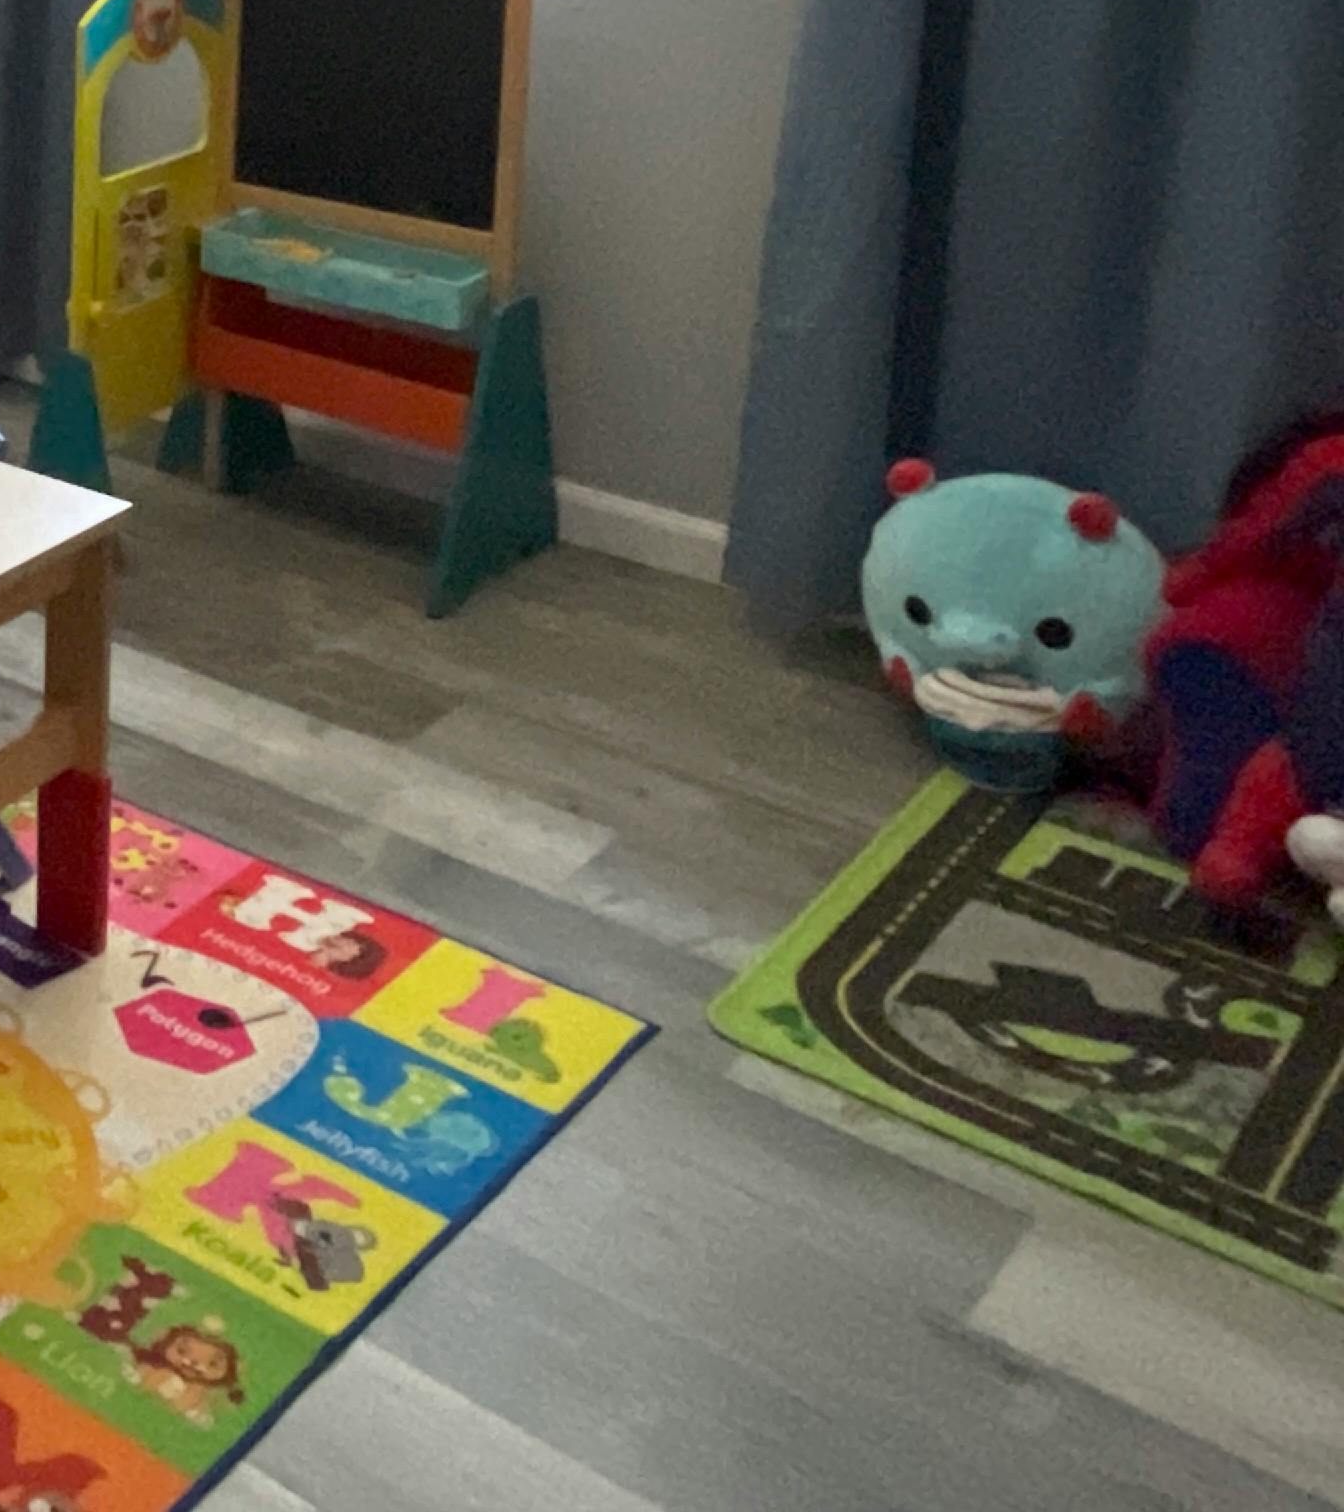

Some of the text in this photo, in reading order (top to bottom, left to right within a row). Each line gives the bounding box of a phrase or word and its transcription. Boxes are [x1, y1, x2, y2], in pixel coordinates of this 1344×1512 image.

[199, 927, 333, 996] Hedgehog
[135, 1003, 236, 1060] Polygon
[417, 1024, 524, 1083] Iguana
[296, 1118, 412, 1183] Jellyfish
[180, 1220, 279, 1282] Koala
[40, 1339, 117, 1400] Lion
